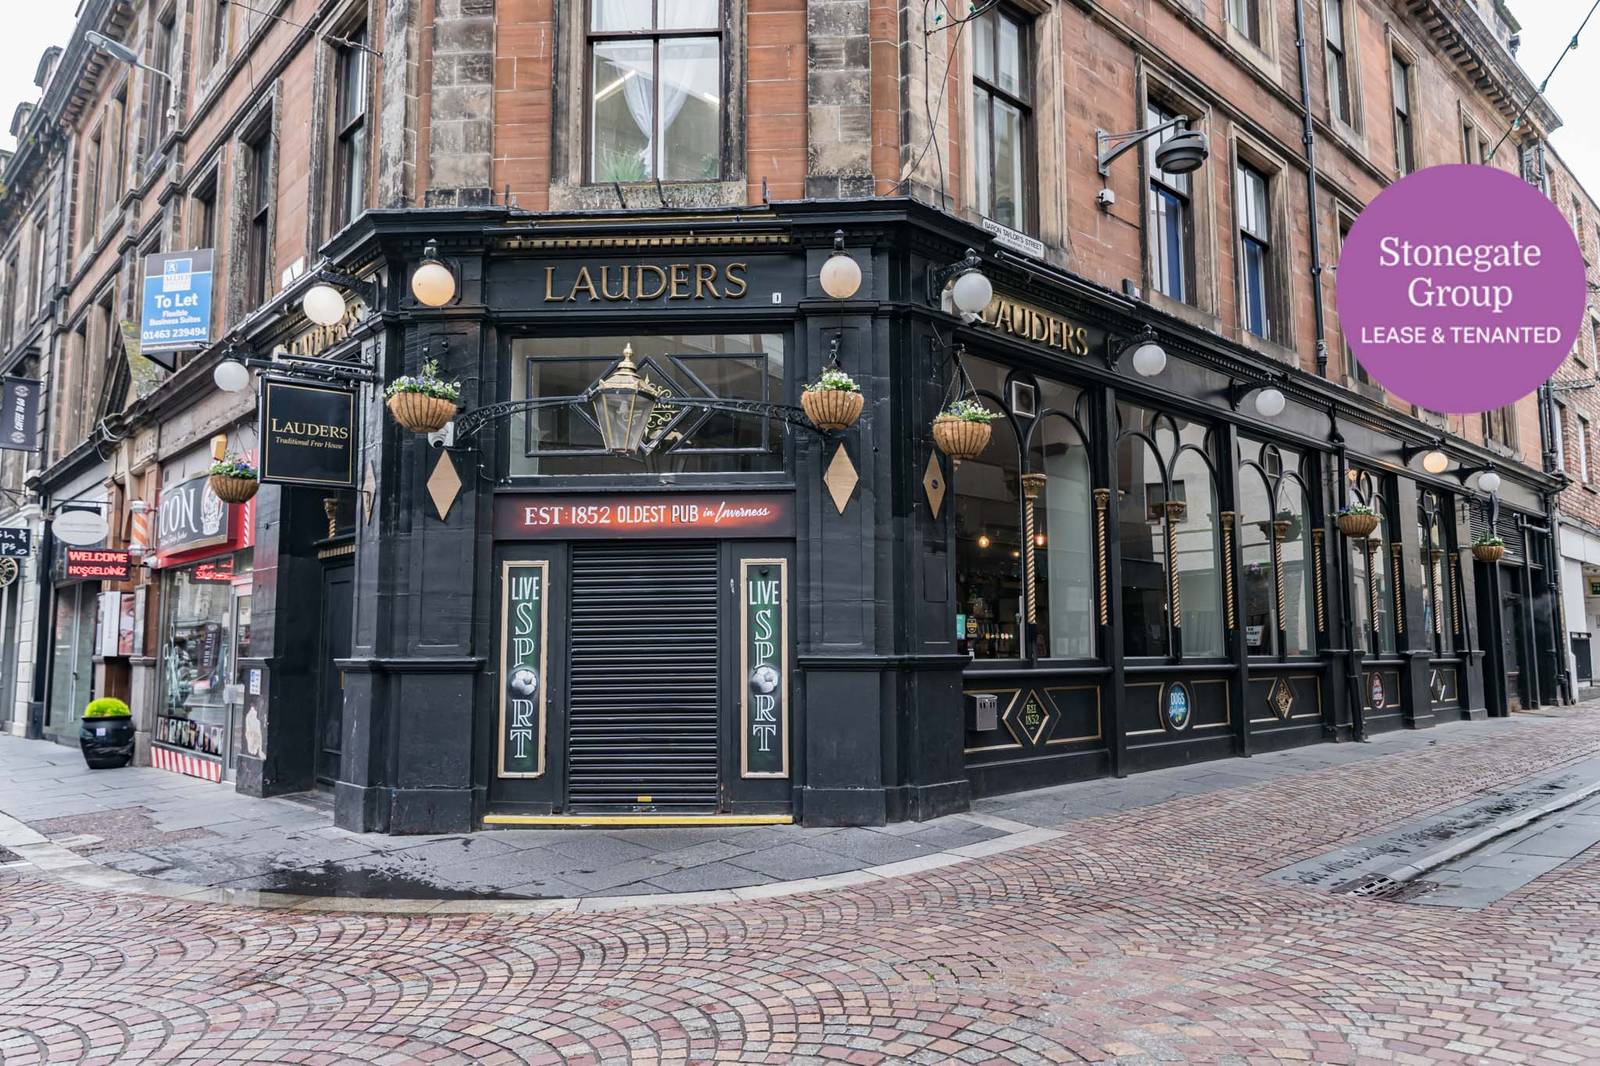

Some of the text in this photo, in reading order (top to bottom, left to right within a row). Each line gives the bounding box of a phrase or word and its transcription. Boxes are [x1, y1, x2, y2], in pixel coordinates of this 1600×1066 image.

[985, 221, 1002, 235] BARON
[1025, 239, 1042, 250] STREET
[544, 262, 748, 302] LAUDERS
[154, 292, 198, 309] To Let
[143, 330, 170, 340] 01463
[14, 412, 25, 431] COFFEE
[271, 418, 349, 439] LAUDERS
[275, 436, 344, 449] Traditional Free House
[617, 505, 666, 523] OLDEST
[671, 505, 699, 523] PUB
[703, 507, 715, 518] in
[714, 501, 770, 523] Inverness
[68, 551, 127, 562] WELCOME
[511, 577, 540, 600] LIVE
[749, 580, 779, 605] LIVE
[1170, 692, 1185, 704] DOGS
[1025, 714, 1040, 725] 1852
